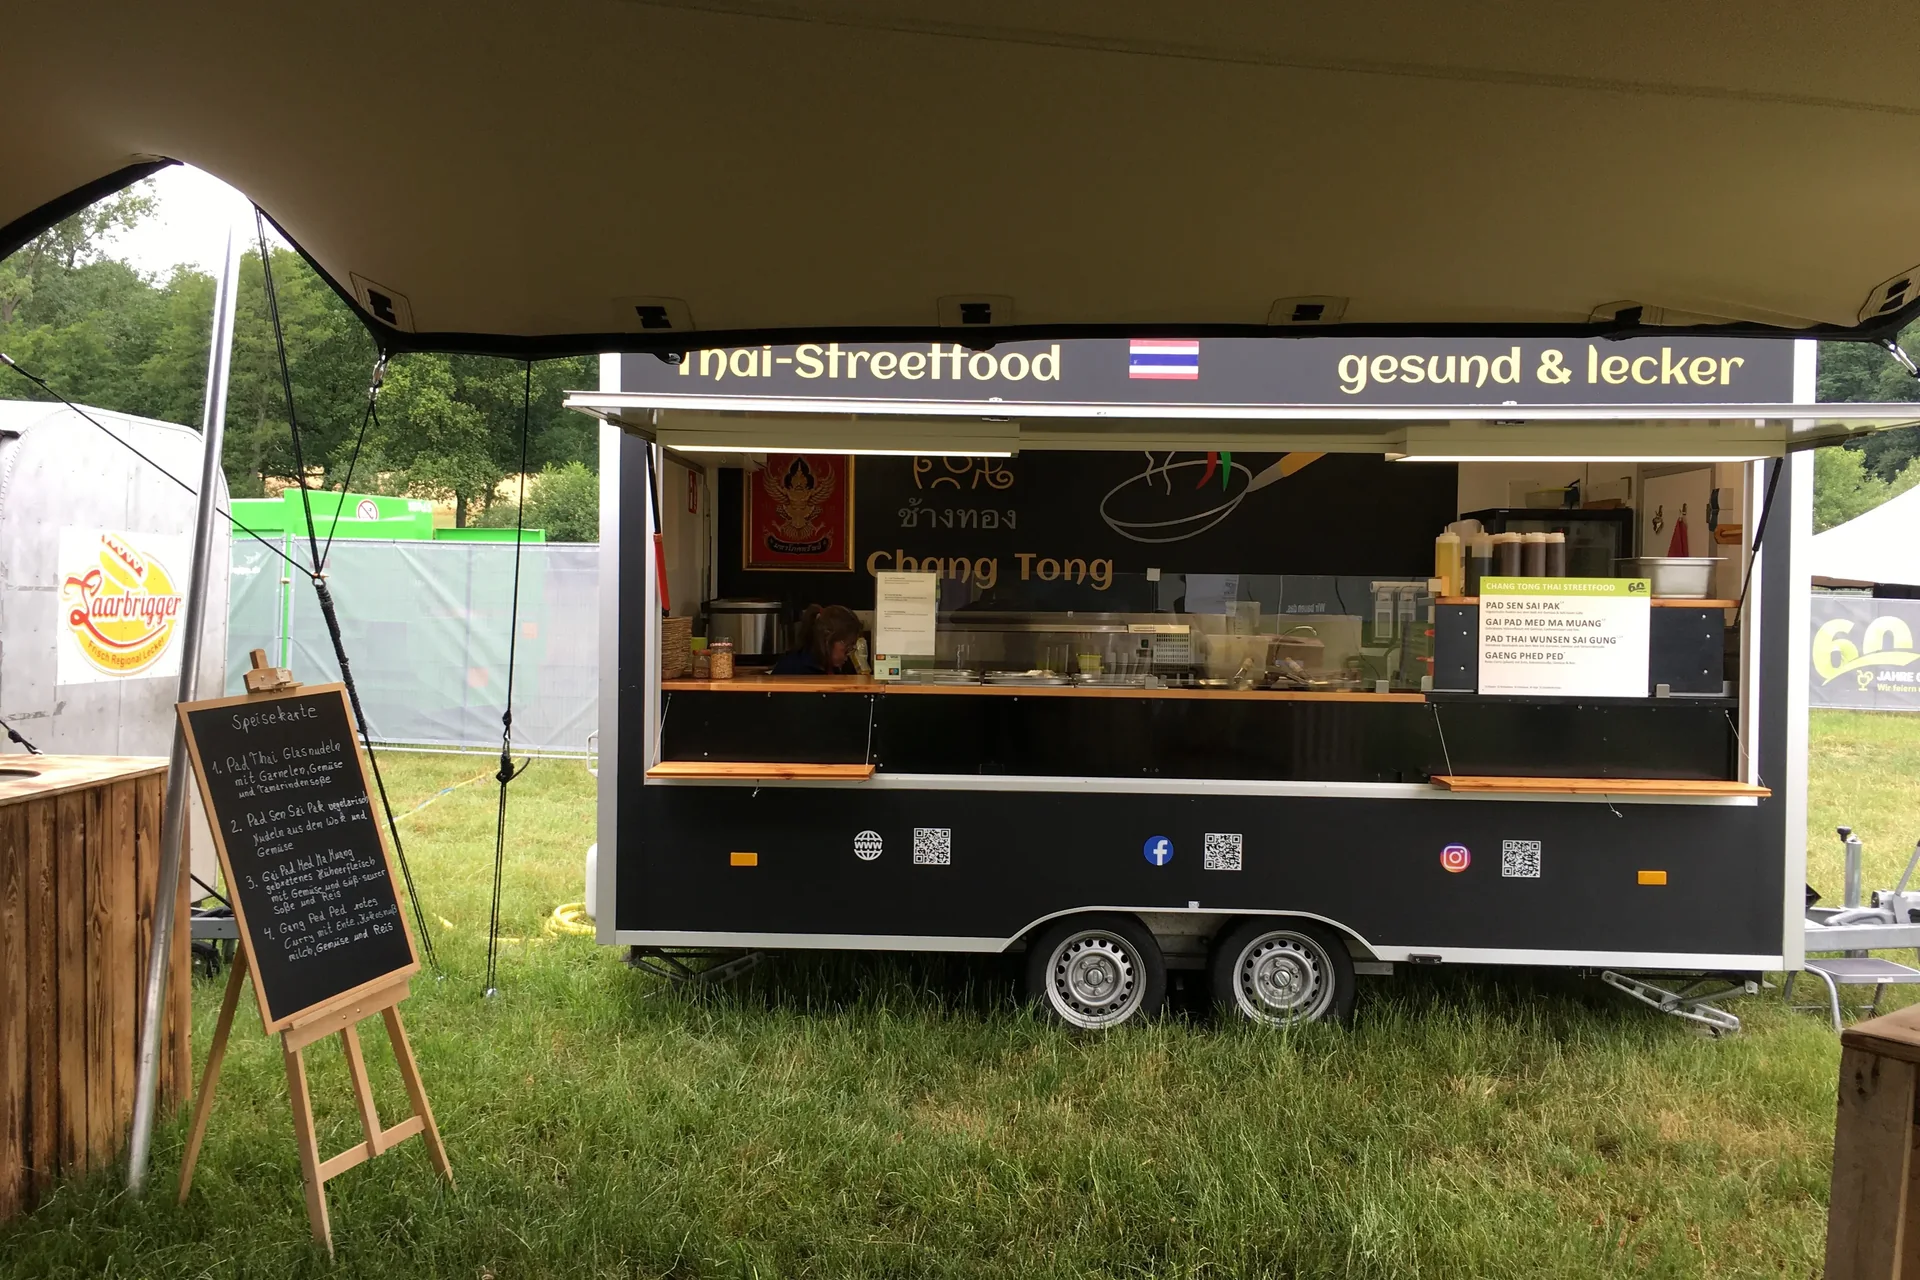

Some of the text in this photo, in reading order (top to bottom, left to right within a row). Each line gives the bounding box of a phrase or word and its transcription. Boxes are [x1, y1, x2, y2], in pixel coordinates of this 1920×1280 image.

[1337, 345, 1745, 395] gesund & lecker
[898, 497, 1017, 530] ช้างทอง
[866, 549, 1113, 591] Chang Tong
[1486, 582, 1616, 592] CHANG TONG THAI STREETFOOD
[1486, 601, 1504, 610] PAD
[1506, 601, 1524, 610] SEN
[1526, 602, 1541, 610] SAI
[1542, 602, 1560, 611] PAK
[1485, 618, 1502, 626] GAI
[1504, 618, 1522, 626] PAD
[1525, 618, 1546, 627] MED
[1548, 619, 1563, 627] MA
[1566, 619, 1602, 628] MUANG
[1485, 635, 1503, 643] PAD
[1506, 635, 1527, 643] THAI
[1529, 636, 1570, 644] WUNSEN
[1572, 636, 1587, 644] SAI
[1590, 636, 1617, 645] GUNG
[87, 637, 166, 668] Frisch Regional Lecker
[1485, 651, 1564, 661] GAENG PHED PED
[1877, 671, 1914, 682] JAHRE
[1892, 684, 1916, 692] feiern
[231, 703, 318, 734] Speisekarte
[212, 760, 223, 775] 1.
[226, 755, 250, 773] Pad
[248, 751, 278, 766] Thai
[235, 771, 256, 787] mit
[238, 789, 256, 799] und
[231, 820, 243, 834] 2.
[246, 811, 268, 828] Pad
[268, 810, 286, 822] Sen
[287, 804, 305, 818] Sai
[307, 799, 325, 814] Pak
[252, 827, 285, 847] Nudeln
[286, 825, 304, 836] aus
[351, 809, 368, 821] und
[257, 842, 294, 858] Gemüse
[246, 875, 258, 890] 3.
[279, 861, 297, 877] Pad
[271, 890, 289, 903] mit
[291, 885, 324, 900] Gemüse
[325, 879, 340, 891] und
[273, 890, 342, 916] Soße und Reis
[263, 927, 275, 940] 4.
[308, 911, 326, 924] Ped
[328, 904, 347, 918] Ped
[354, 928, 369, 941] und
[373, 922, 394, 936] Reis
[284, 934, 316, 950] Curry
[317, 922, 333, 938] mit
